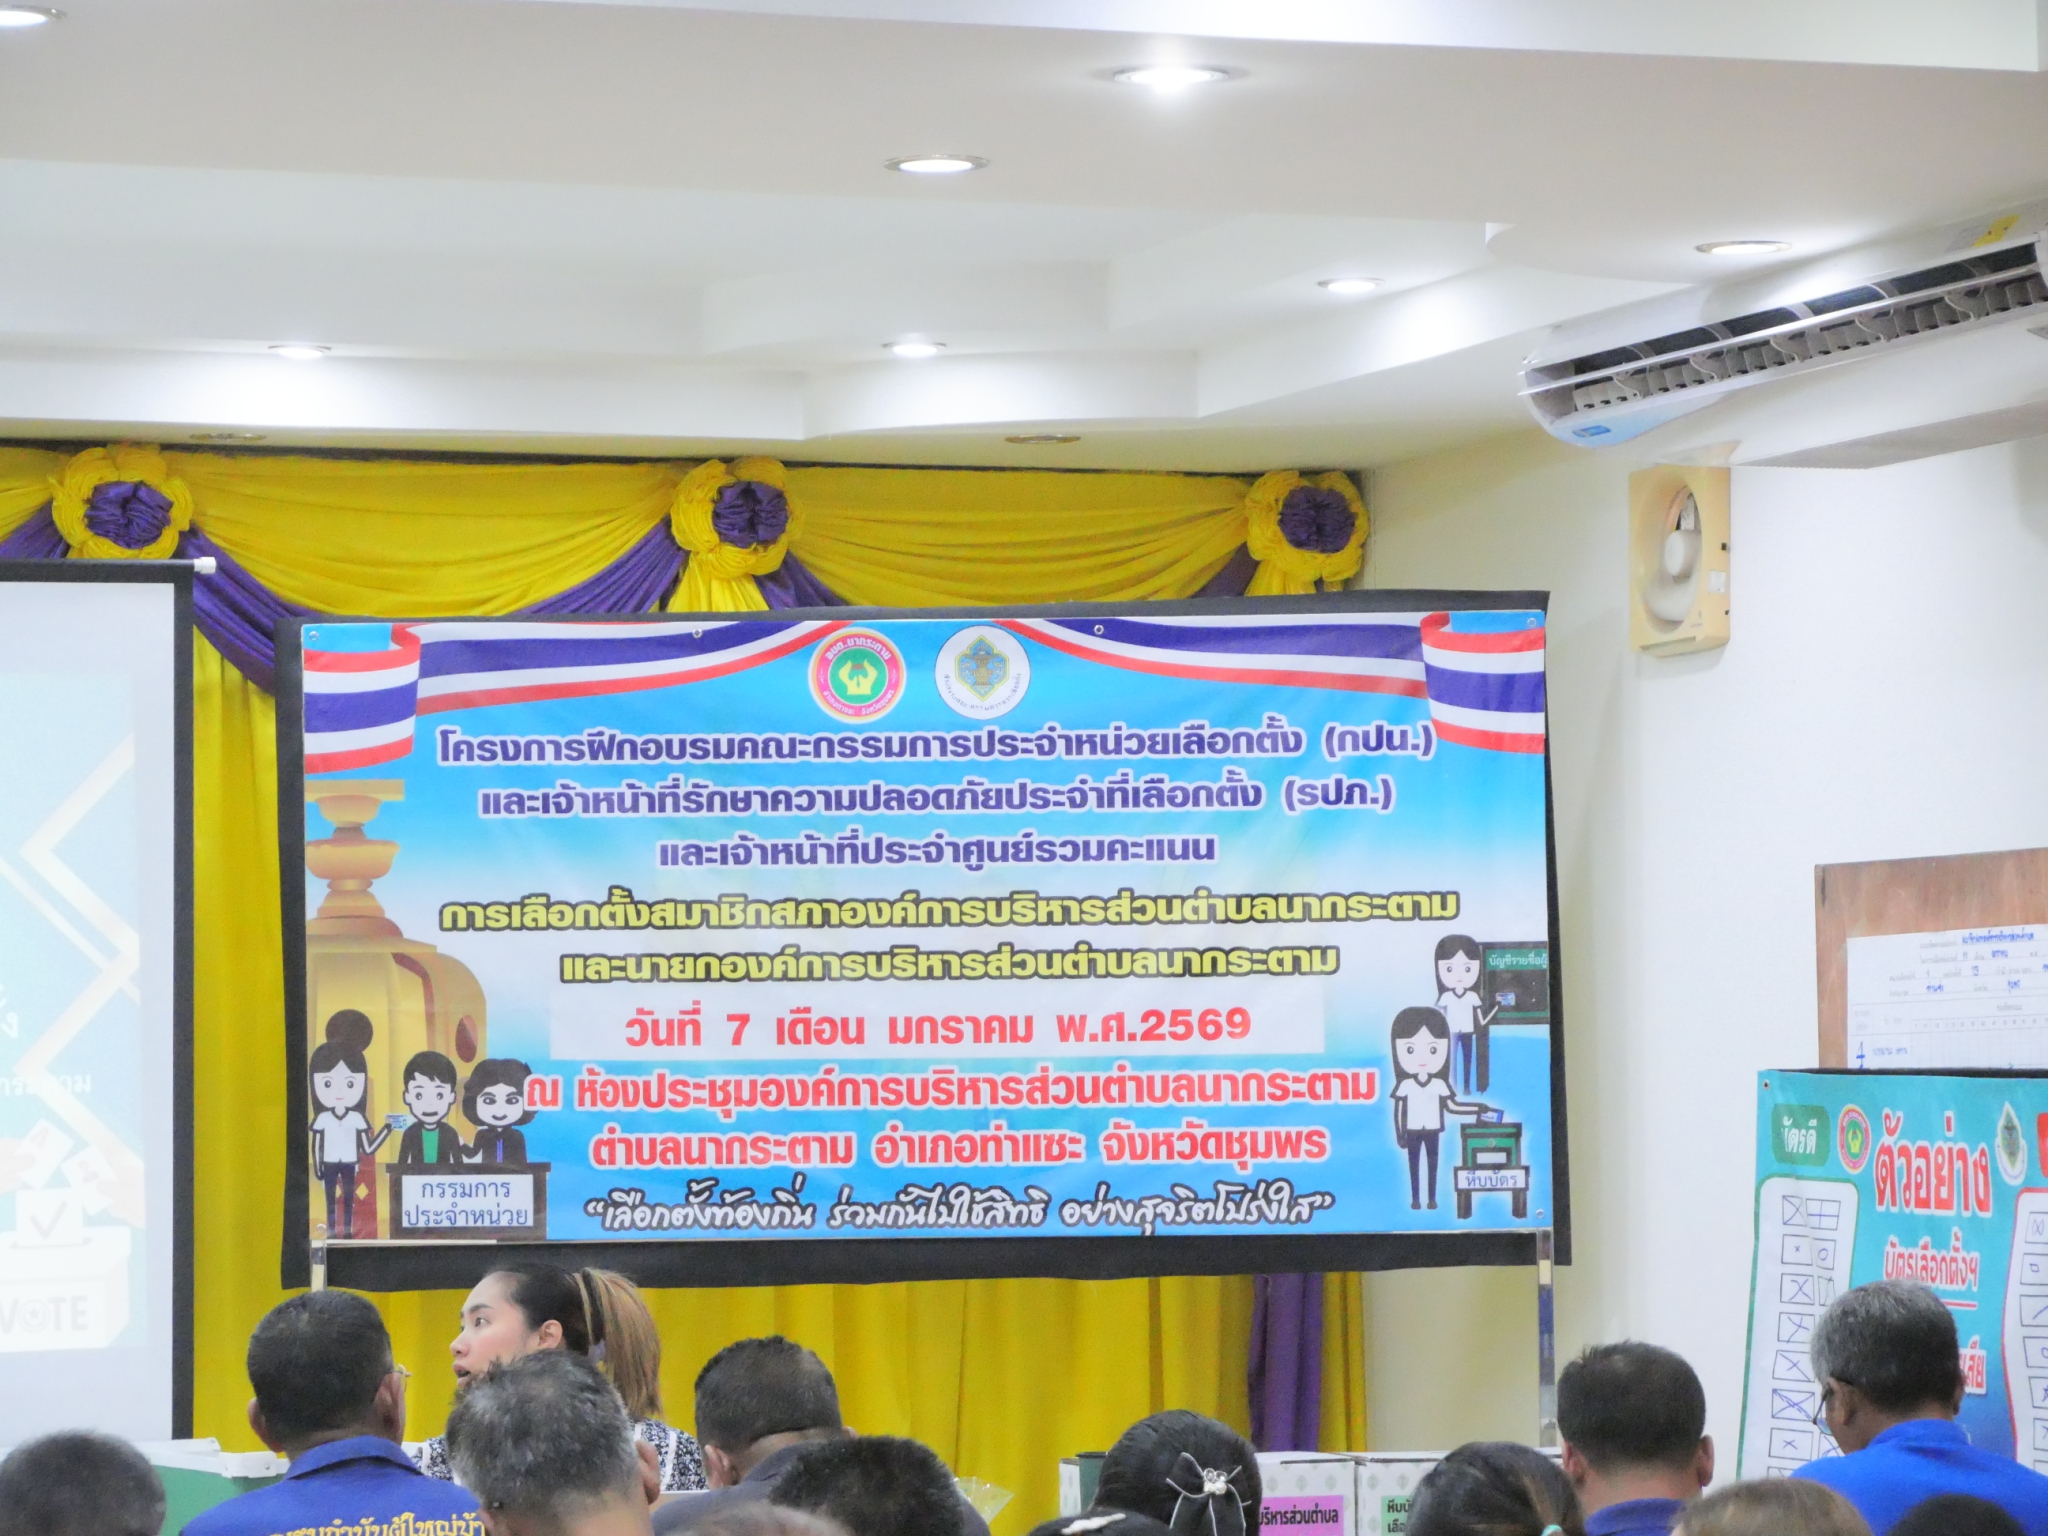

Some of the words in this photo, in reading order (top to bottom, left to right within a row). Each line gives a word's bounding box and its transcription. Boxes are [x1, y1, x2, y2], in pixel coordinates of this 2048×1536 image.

[439, 717, 1303, 762] โครงการฝึกอบรมคณะกรรมการประจำหน่วยเลือกตั้ง
[1324, 724, 1437, 760] (กปน.)
[481, 771, 1263, 815] และเจ้าหน้าที่รักษาความปลอดภัยประจำที่เลือกตั้ง
[1283, 778, 1395, 813] (รปภ.)
[659, 829, 1216, 871] และเจ้าหน้าที่ประจำศูนย์รวมคะแนน
[441, 885, 1459, 931] การเลือกตั้งสมาชิกสภาองค์การบริหารส่วนตำบลนากระตาม
[560, 943, 1340, 983] และนายกองค์การบริหารส่วนตำบลนากระตาม
[626, 1000, 701, 1046] วันที่
[726, 1014, 750, 1045] 7
[776, 1006, 866, 1045] เดือน
[889, 1011, 1034, 1046] มกราคม
[1057, 1006, 1251, 1043] พ.ศ.2569
[526, 1078, 560, 1108] ณ
[576, 1066, 1376, 1119] ห้องประชุมองค์การบริหารส่วนตำบลนากระตาม
[592, 1125, 853, 1167] ตำบลนากระตาม
[874, 1122, 1085, 1166] อำเภอท่าแซะ
[1103, 1121, 1327, 1171] จังหวัดชุมพร
[1877, 1114, 1990, 1213] ตัวอย่าง
[421, 1181, 511, 1198] กรรมการ
[1465, 1168, 1517, 1188] หีบบัตร
[404, 1201, 529, 1227] ประจำหน่วย
